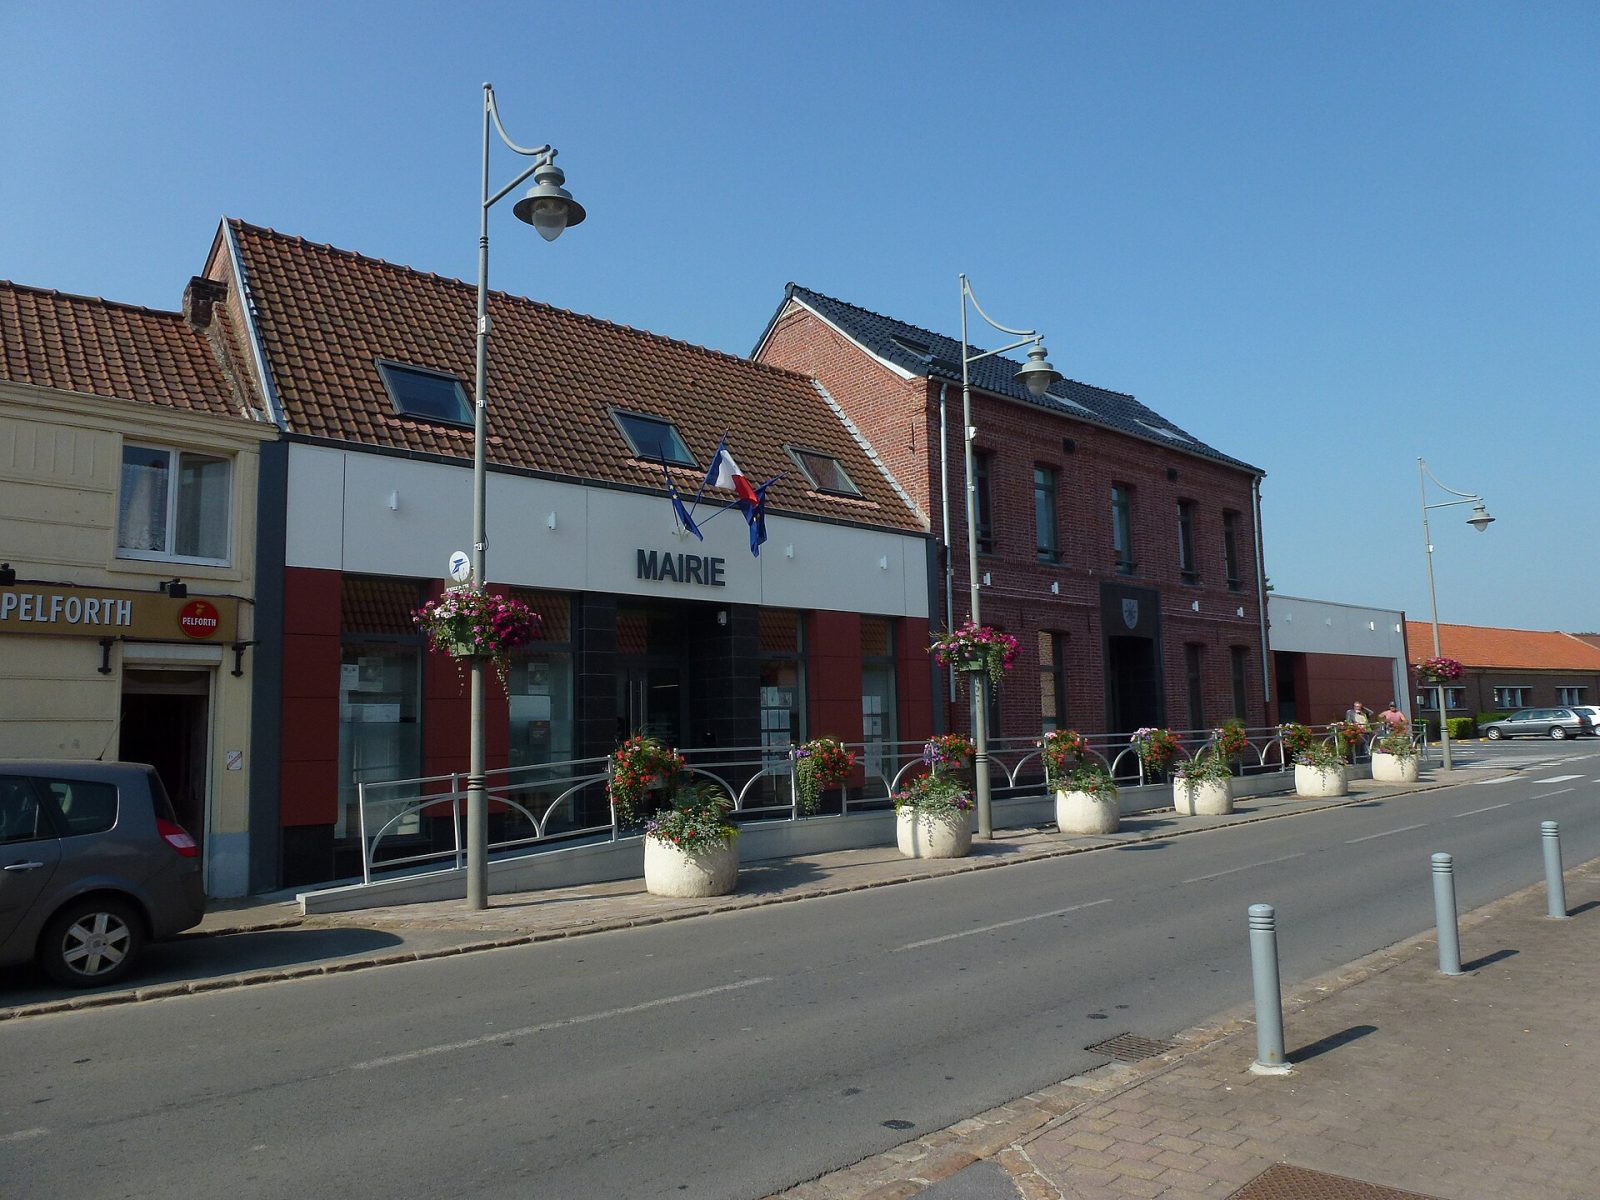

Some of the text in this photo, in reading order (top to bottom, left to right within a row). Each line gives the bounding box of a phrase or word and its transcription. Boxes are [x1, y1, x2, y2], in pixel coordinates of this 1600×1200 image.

[637, 549, 725, 586] MAIRIE
[0, 592, 132, 626] PELFORTH
[182, 617, 217, 626] PELFORTH
